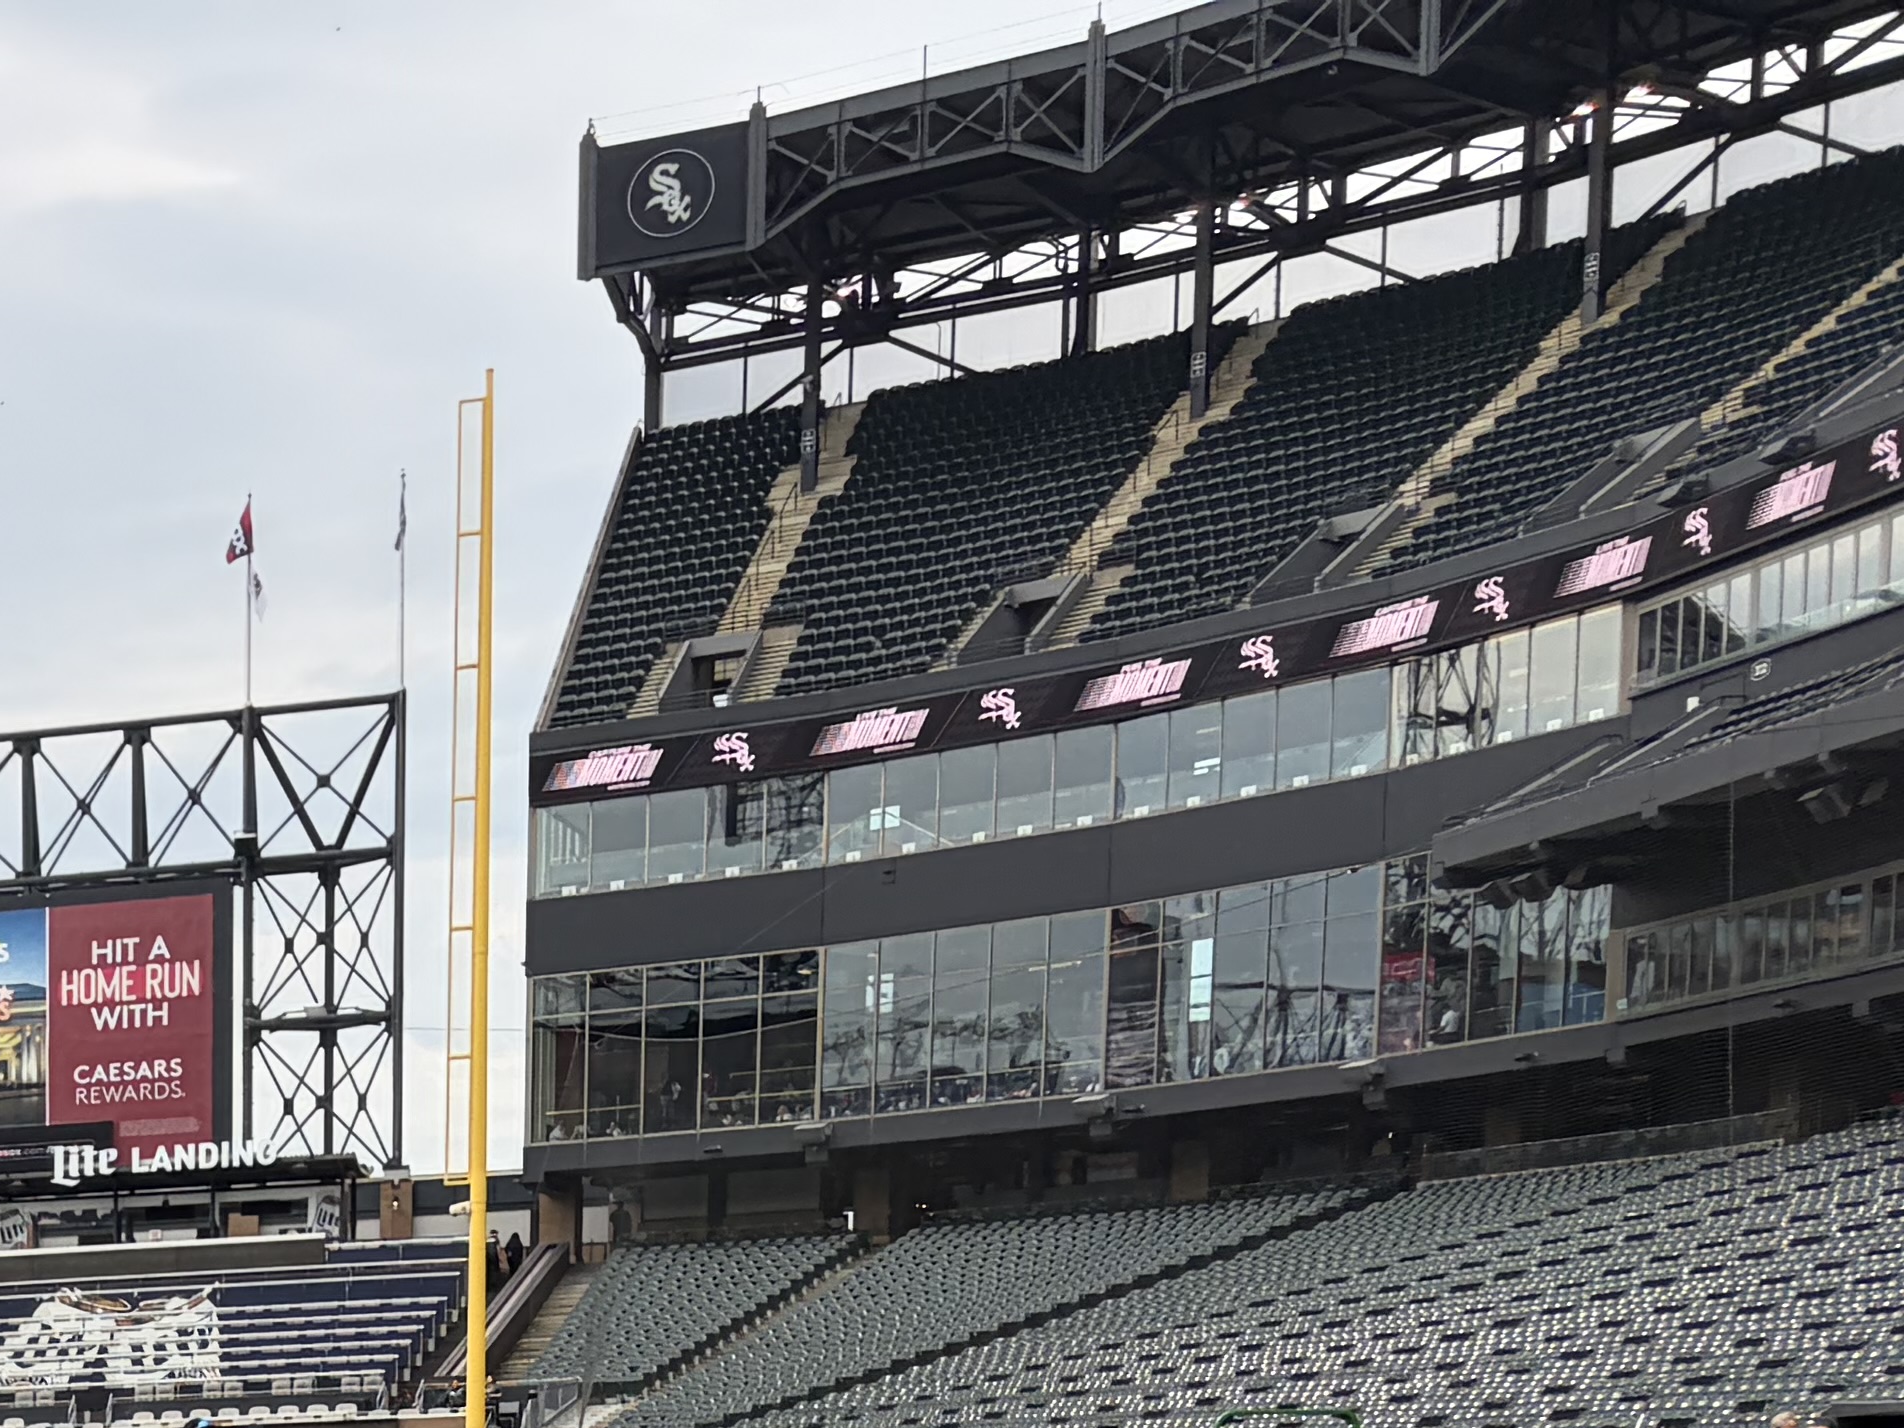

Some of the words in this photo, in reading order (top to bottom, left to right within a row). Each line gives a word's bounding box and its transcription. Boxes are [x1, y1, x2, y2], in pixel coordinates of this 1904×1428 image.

[92, 937, 139, 964] HIT
[148, 935, 170, 960] A
[61, 964, 137, 1006] HOME
[146, 959, 200, 999] RUN
[91, 1002, 168, 1031] WITH
[73, 1057, 183, 1085] CAESARS
[50, 1144, 118, 1187] Lite
[130, 1139, 278, 1174] LANDING
